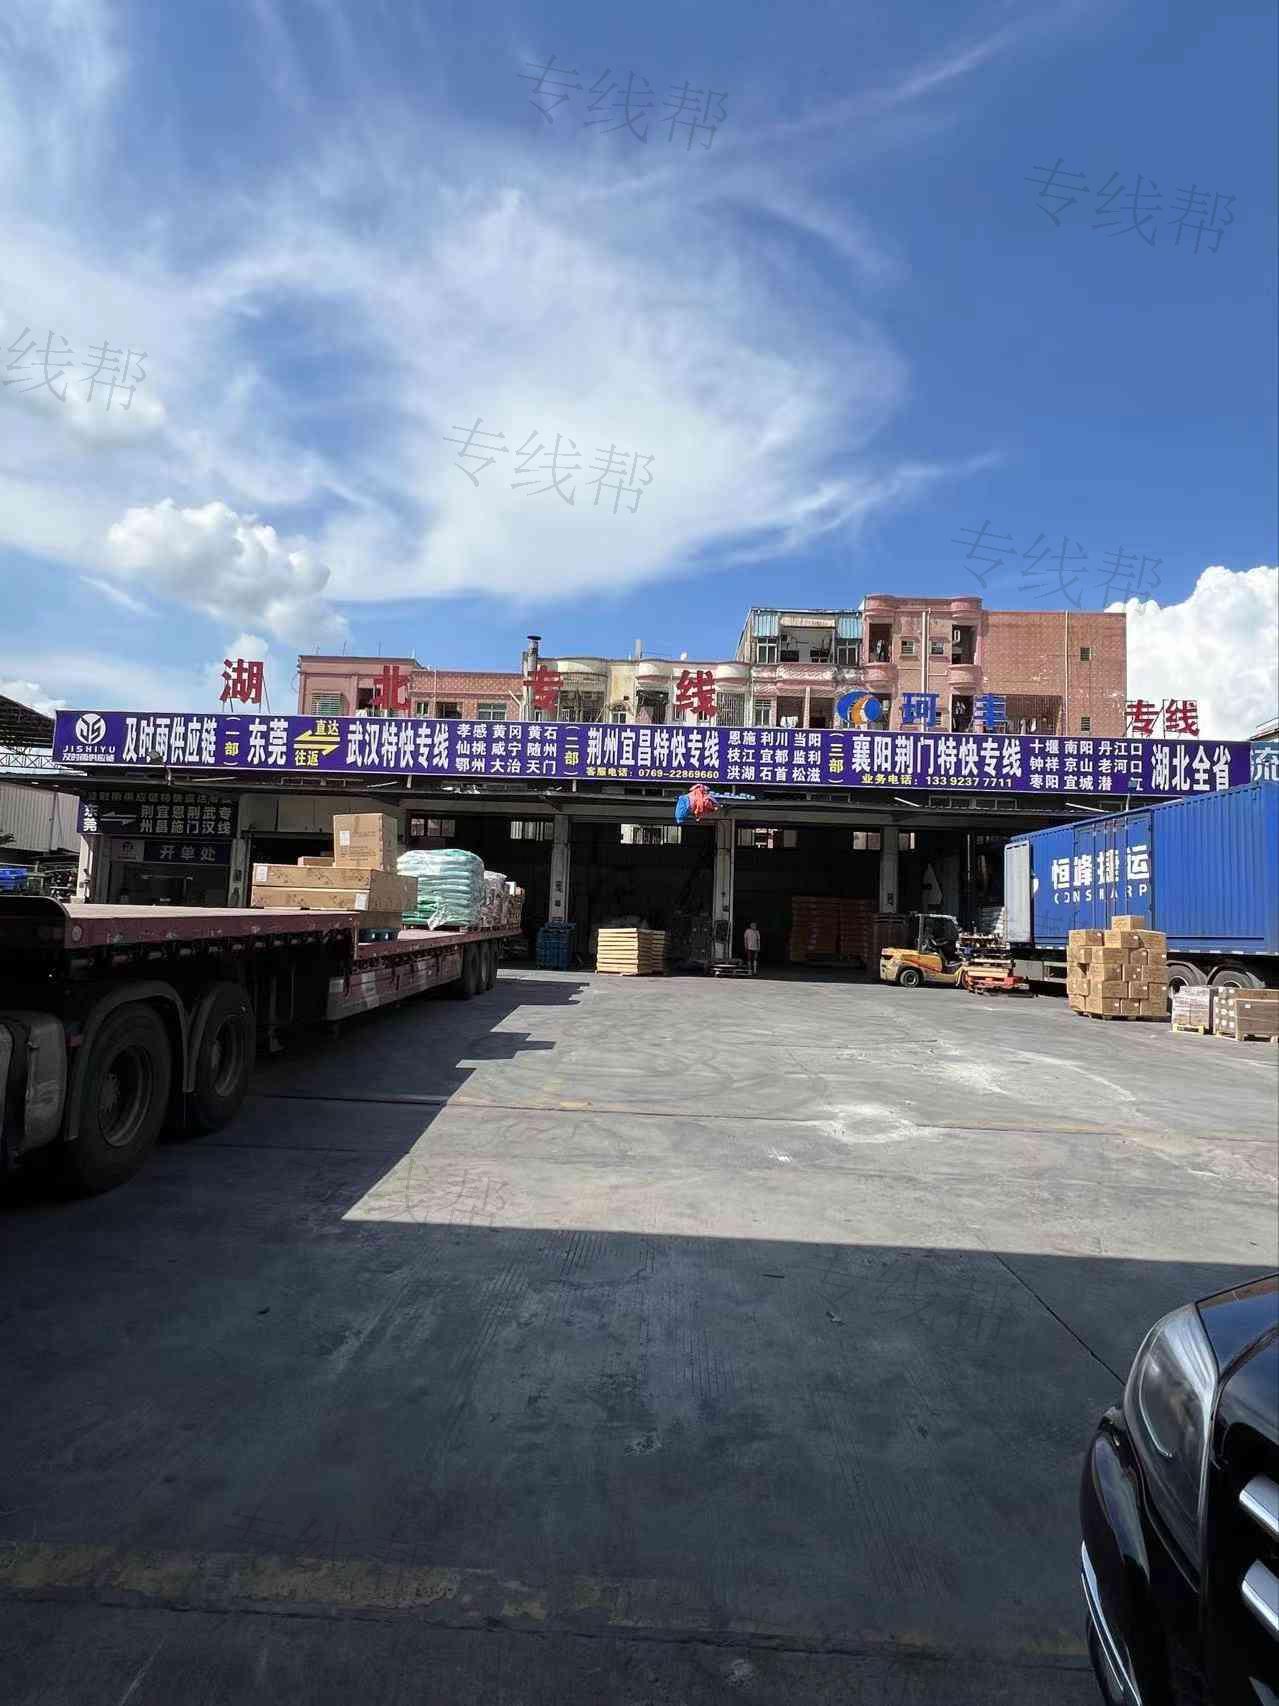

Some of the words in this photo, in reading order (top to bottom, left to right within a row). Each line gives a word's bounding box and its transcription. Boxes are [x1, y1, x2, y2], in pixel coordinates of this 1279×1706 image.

[1124, 699, 1200, 737] 专线
[315, 720, 339, 736] 直达
[457, 724, 487, 738] 孝感
[492, 724, 522, 739] 黄冈
[528, 725, 558, 740] 黄石
[123, 717, 217, 763] 及时雨供应链
[248, 718, 288, 765] 东莞
[346, 721, 449, 769] 武汉特快专线
[587, 727, 719, 768] 荆州宜昌特快专线
[728, 731, 756, 745] 恩施
[761, 731, 788, 746] 利川
[794, 732, 821, 747] 当阳
[1030, 739, 1059, 754] 十堰
[1064, 740, 1093, 754] 南阳
[1098, 741, 1142, 756] 丹江口
[63, 745, 115, 753] JISHIYU
[456, 740, 486, 755] 仙桃
[491, 741, 521, 756] 咸宁
[527, 742, 556, 758] 随州
[727, 748, 755, 763] 枝江
[760, 748, 788, 764] 宜都
[793, 750, 821, 765] 监利
[852, 734, 1022, 777] 襄阳荆门特快专线
[295, 750, 319, 766] 往返
[456, 757, 485, 772] 鄂州
[526, 760, 556, 775] 天门
[1030, 756, 1059, 772] 钟祥
[1064, 757, 1093, 772] 京山
[1098, 758, 1142, 774] 老河口
[727, 765, 755, 780] 洪湖
[760, 767, 788, 781] 石首
[792, 768, 821, 782] 松滋
[1151, 744, 1231, 791] 湖北全省
[926, 776, 947, 786] 133
[950, 777, 978, 786] 9237
[984, 778, 1012, 788] 7711
[1030, 773, 1058, 789] 枣阳
[160, 845, 216, 861] 开单处
